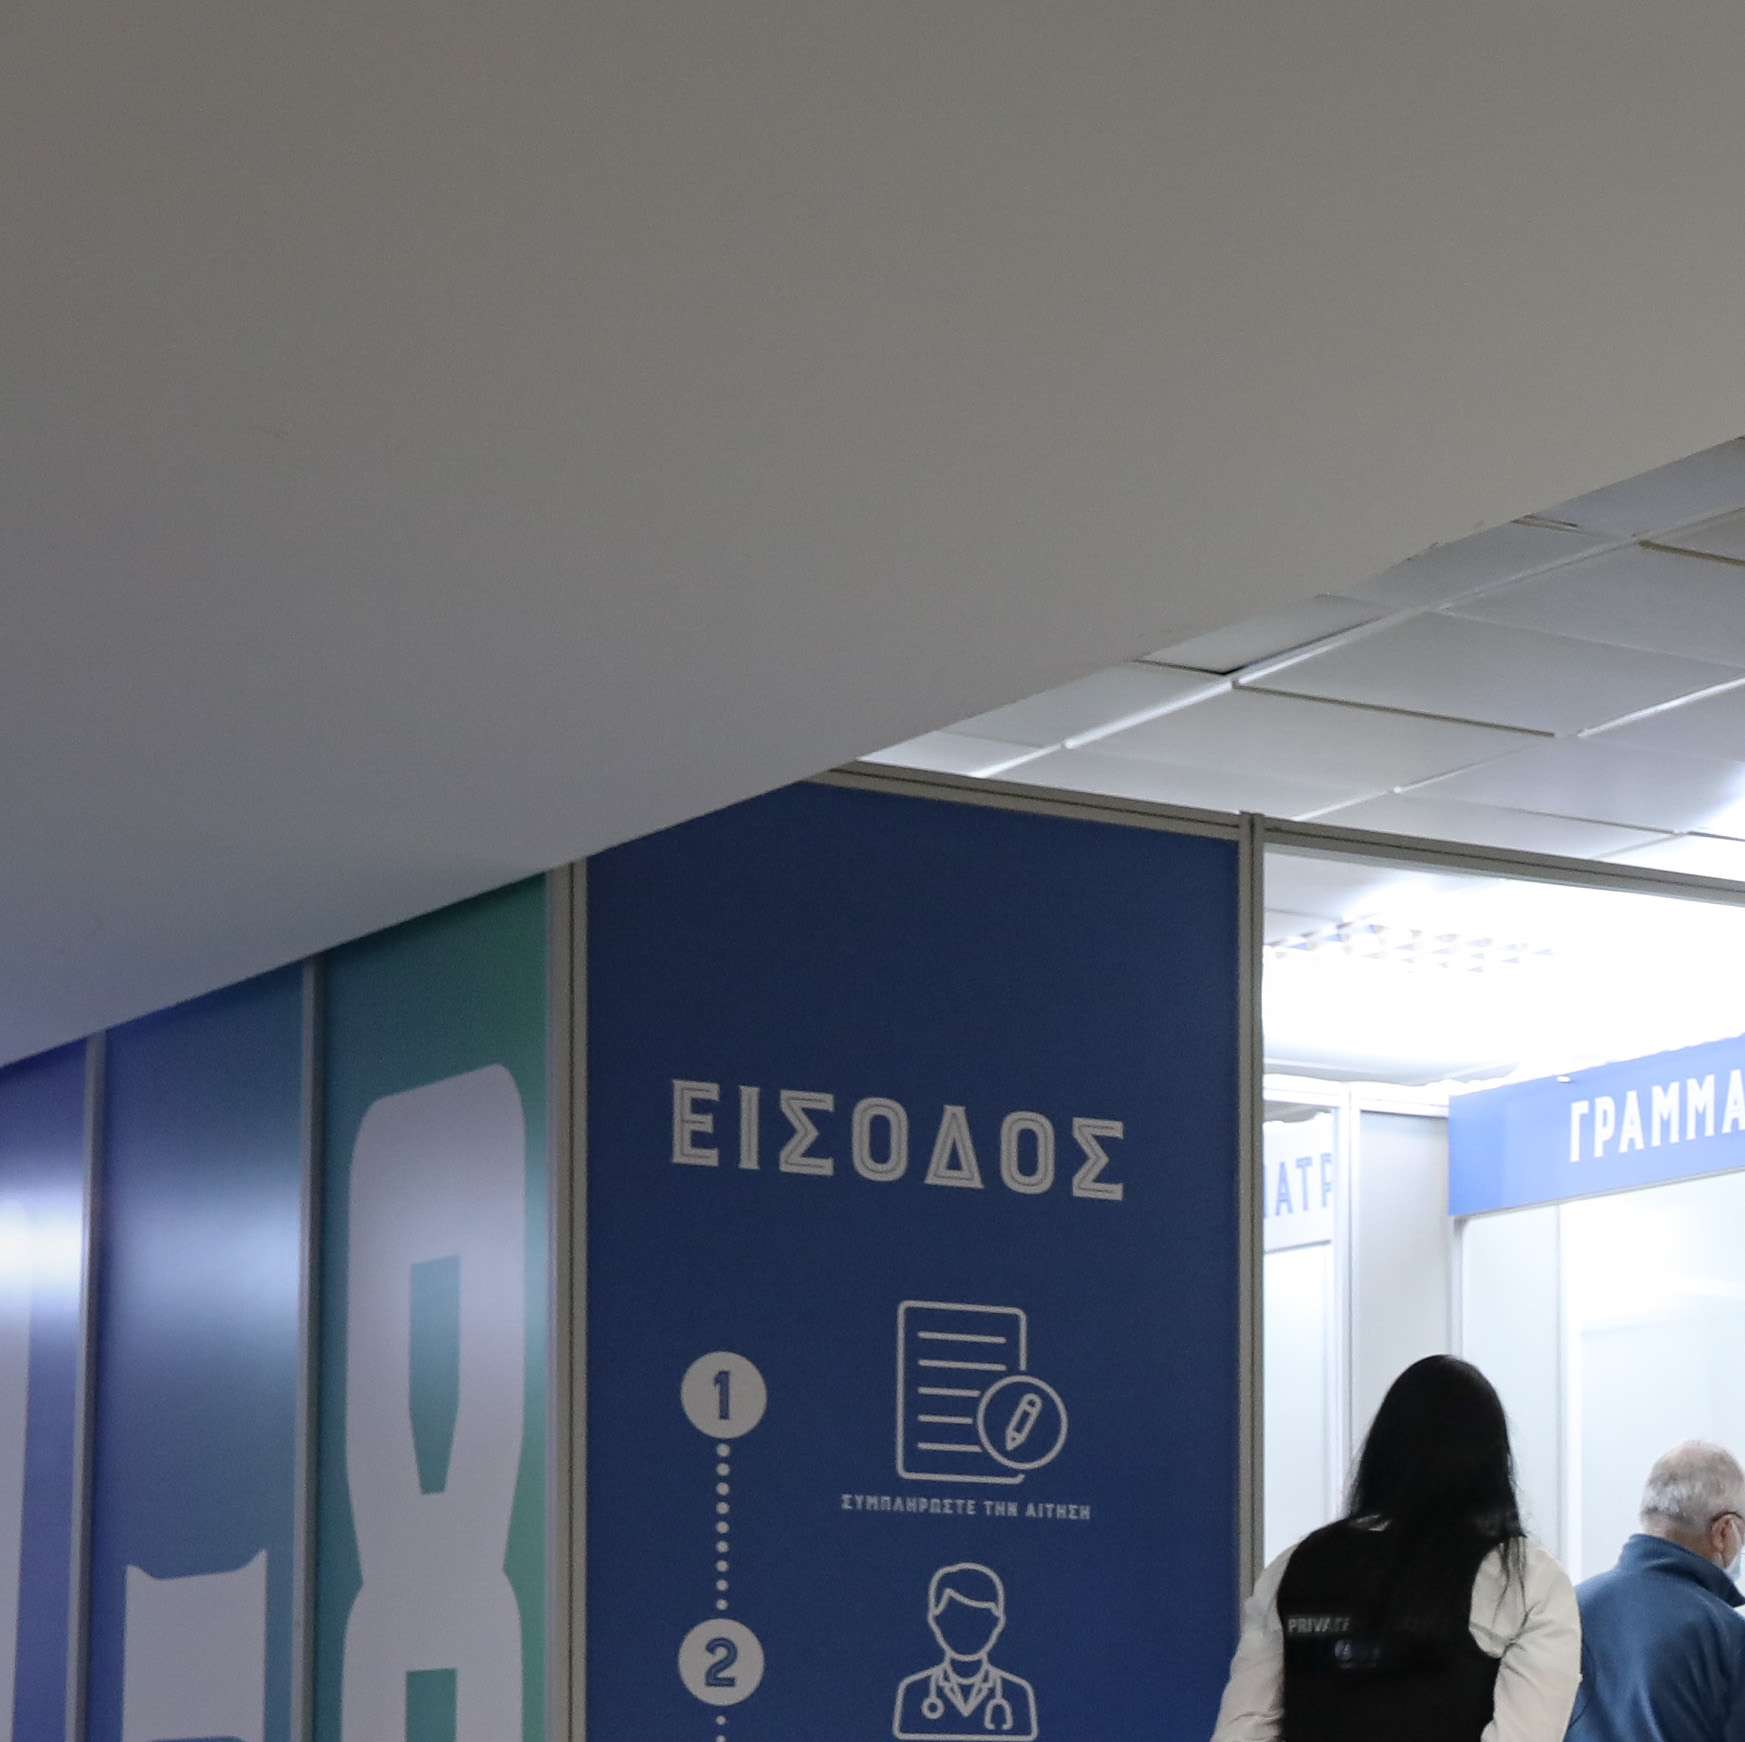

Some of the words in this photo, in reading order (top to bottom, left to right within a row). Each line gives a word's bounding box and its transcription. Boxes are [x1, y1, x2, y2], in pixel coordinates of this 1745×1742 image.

[671, 1079, 1125, 1201] ΕΙΣΟΔΟΣ
[711, 1369, 732, 1421] 1
[840, 1493, 977, 1516] ΣΥΜΠΛΗΡΩΣΤΕ
[983, 1499, 1019, 1518] ΤΗΝ
[1025, 1502, 1092, 1521] ΑΙΤΗΣΗ
[704, 1636, 738, 1688] 2
